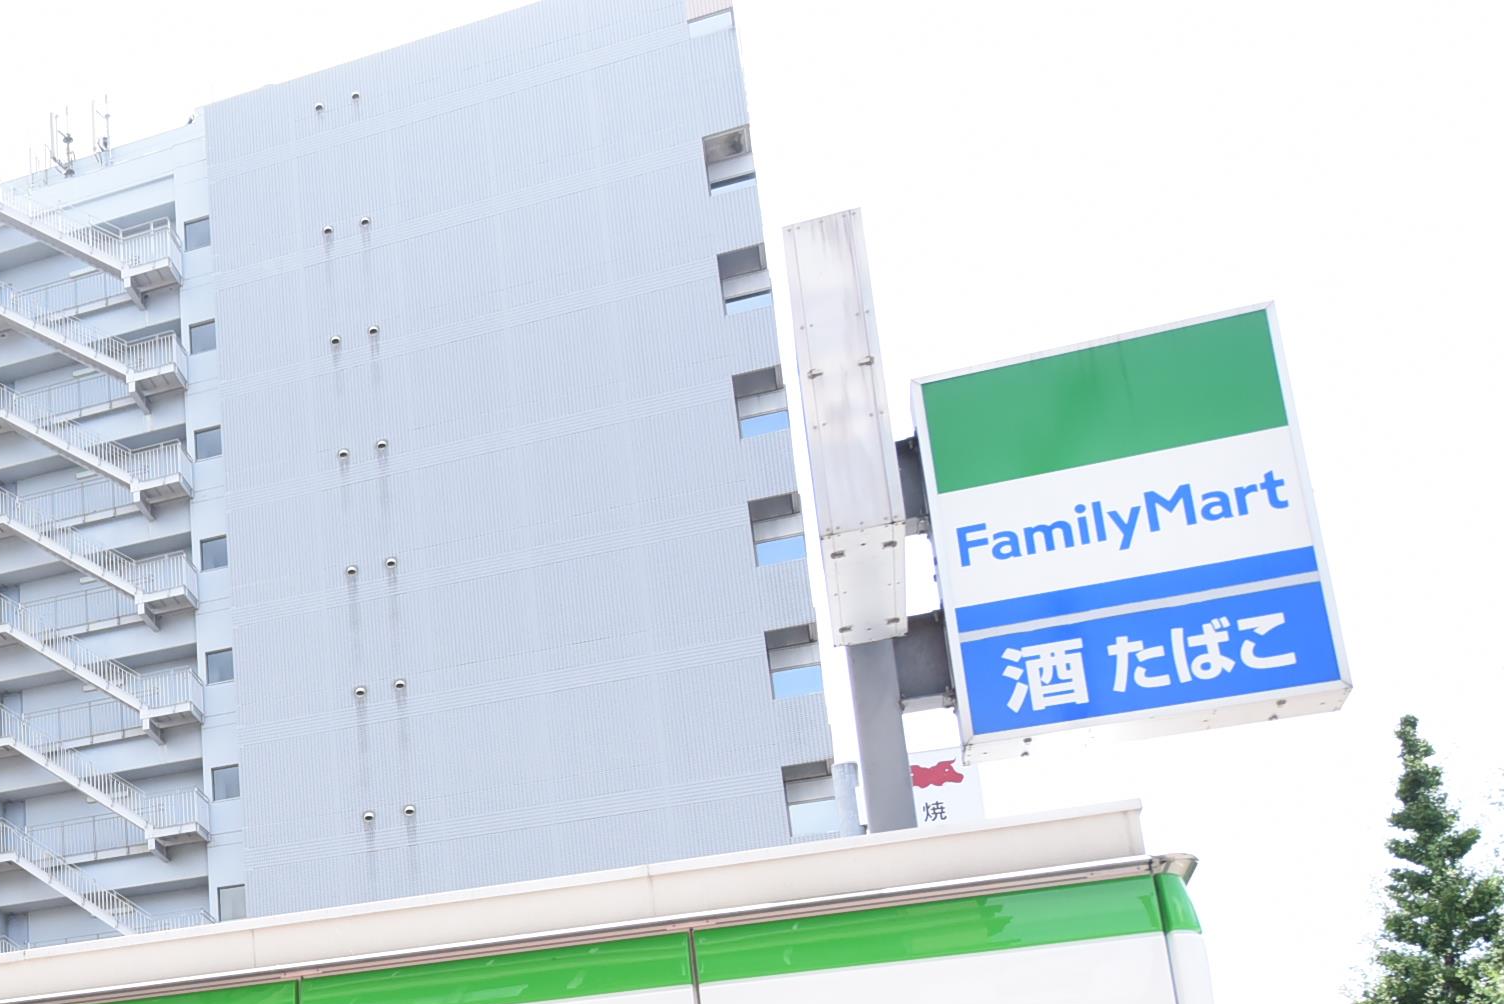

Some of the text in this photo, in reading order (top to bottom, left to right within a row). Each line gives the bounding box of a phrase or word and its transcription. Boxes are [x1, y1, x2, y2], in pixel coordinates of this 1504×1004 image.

[955, 470, 1289, 568] FamilyMart
[1001, 611, 1297, 714] 酒 たばこ
[923, 800, 947, 823] 焼
